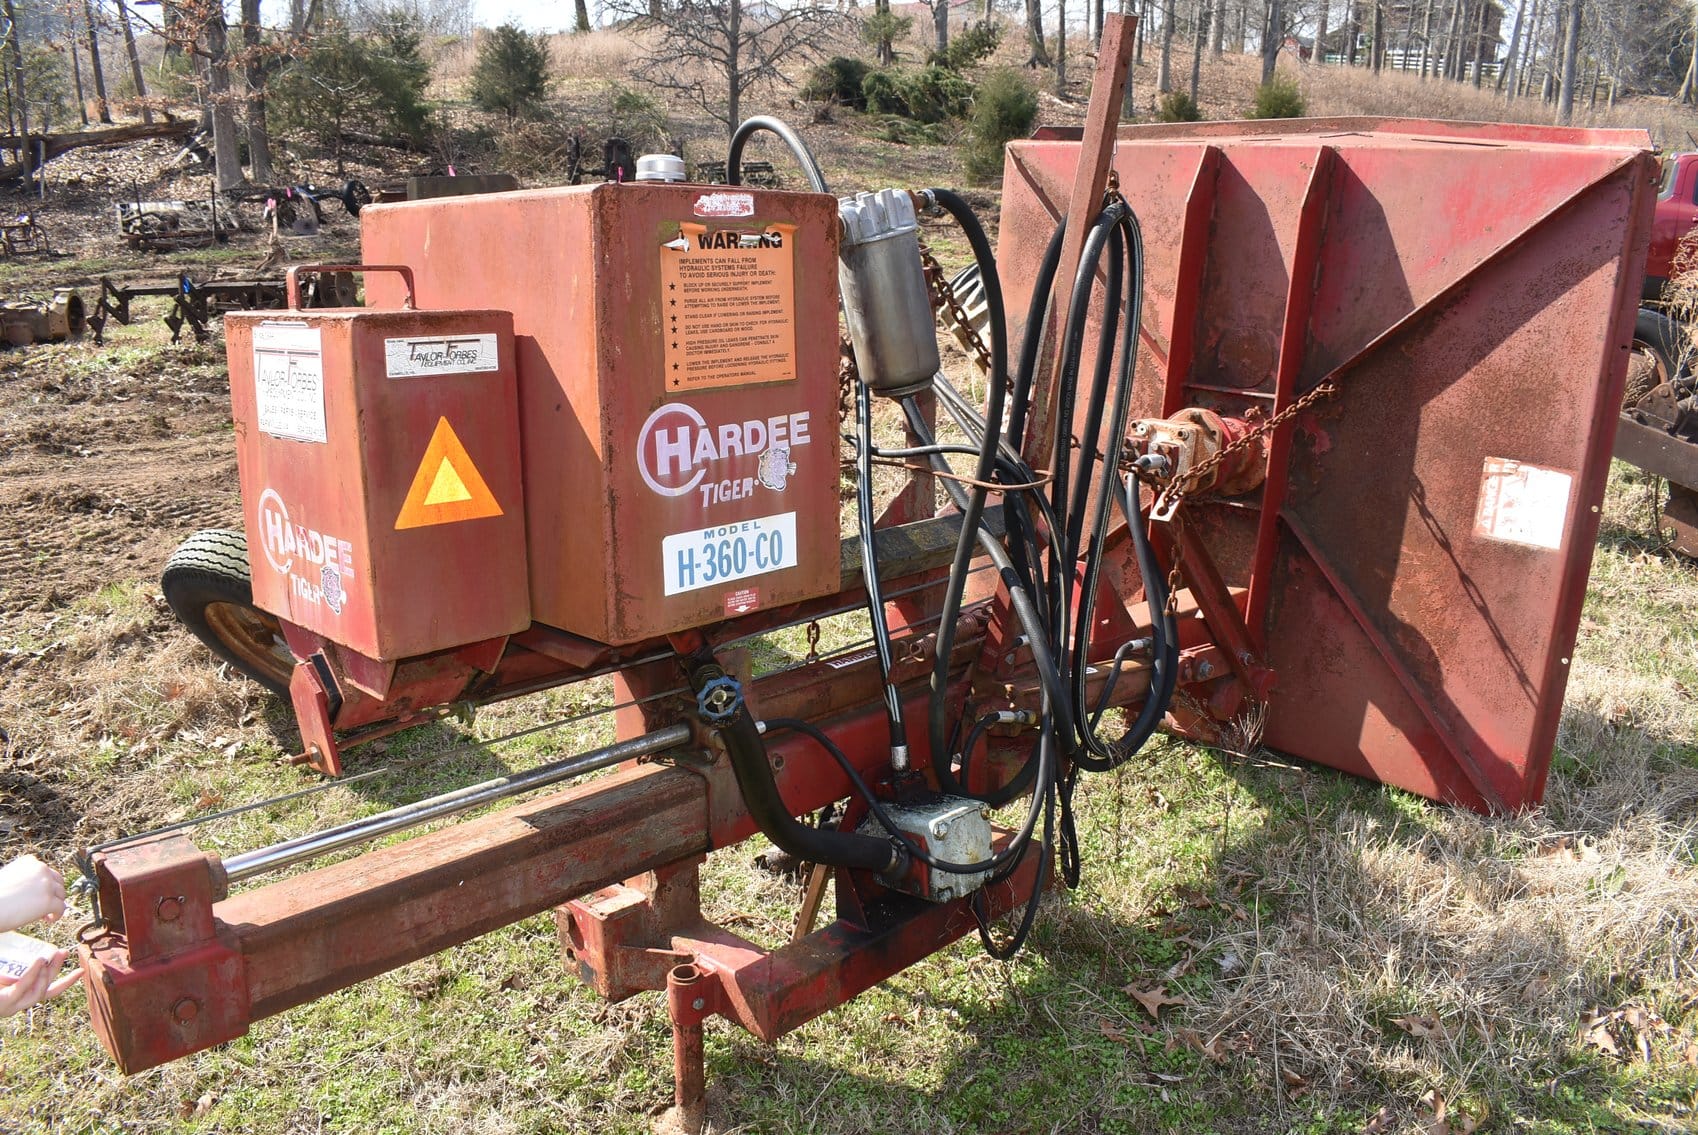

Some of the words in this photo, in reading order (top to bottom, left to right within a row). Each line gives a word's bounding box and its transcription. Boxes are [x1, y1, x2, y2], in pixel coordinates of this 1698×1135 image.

[698, 231, 782, 249] WARNG
[655, 410, 811, 476] HARDEE
[700, 477, 754, 508] TIGER
[258, 500, 355, 579] HARDEE
[704, 521, 761, 540] MODEL
[677, 529, 783, 588] H-360-CO
[290, 572, 321, 605] TIGER
